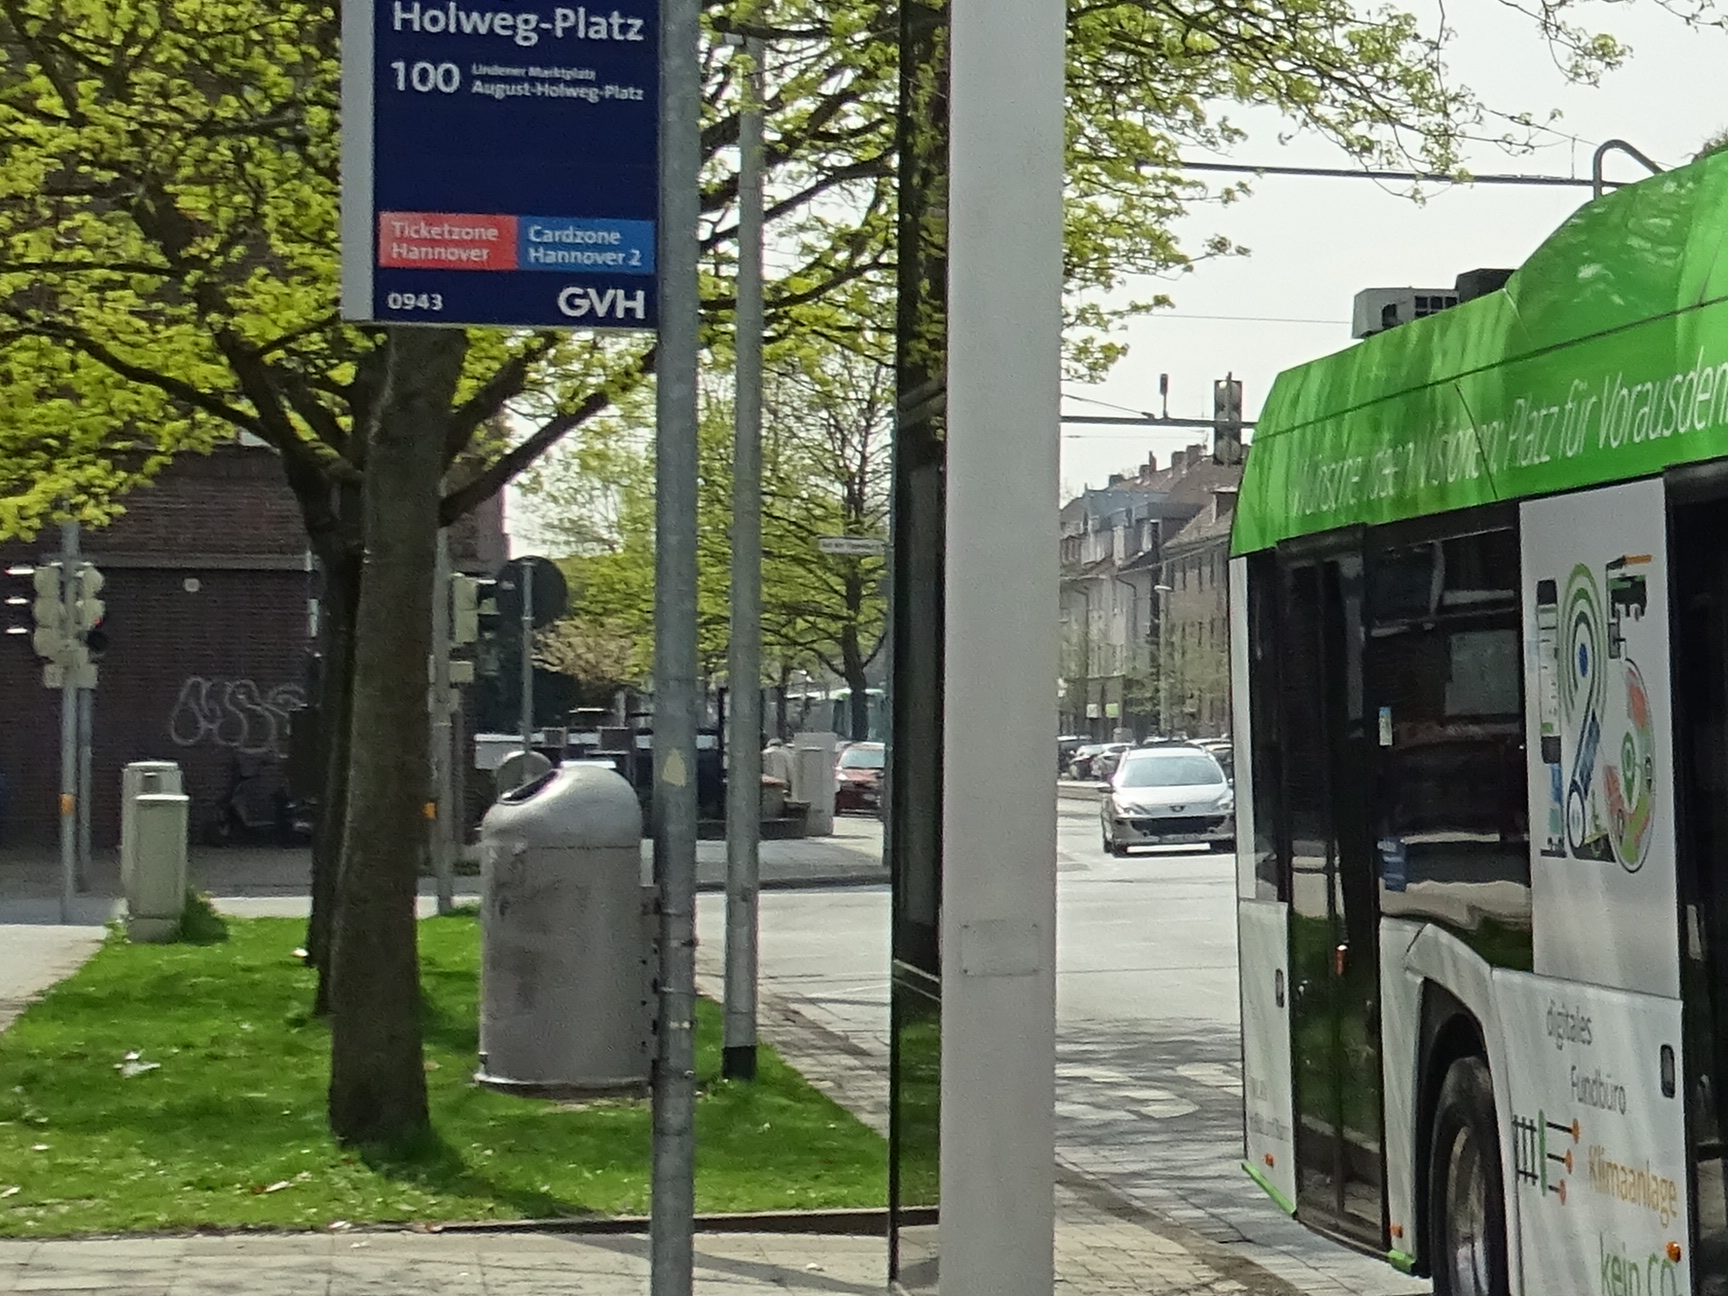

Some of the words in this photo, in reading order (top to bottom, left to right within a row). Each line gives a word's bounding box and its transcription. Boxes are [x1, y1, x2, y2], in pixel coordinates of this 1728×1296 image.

[393, 1, 645, 47] Holweg-Platz
[391, 60, 461, 94] 100
[471, 79, 645, 104] August-Holweg-Platz
[391, 221, 500, 242] Ticketzone
[527, 225, 623, 246] Cardzone
[391, 242, 491, 262] Hannover
[527, 247, 626, 266] Hannover
[627, 249, 643, 267] 2
[387, 291, 444, 312] 0943
[556, 285, 646, 320] GVH
[1503, 391, 1559, 471] Platz
[1558, 378, 1598, 459] für
[1545, 998, 1594, 1051] digitales
[1570, 1064, 1628, 1116] Fundbüro
[1587, 1144, 1679, 1229] Klimaanlage
